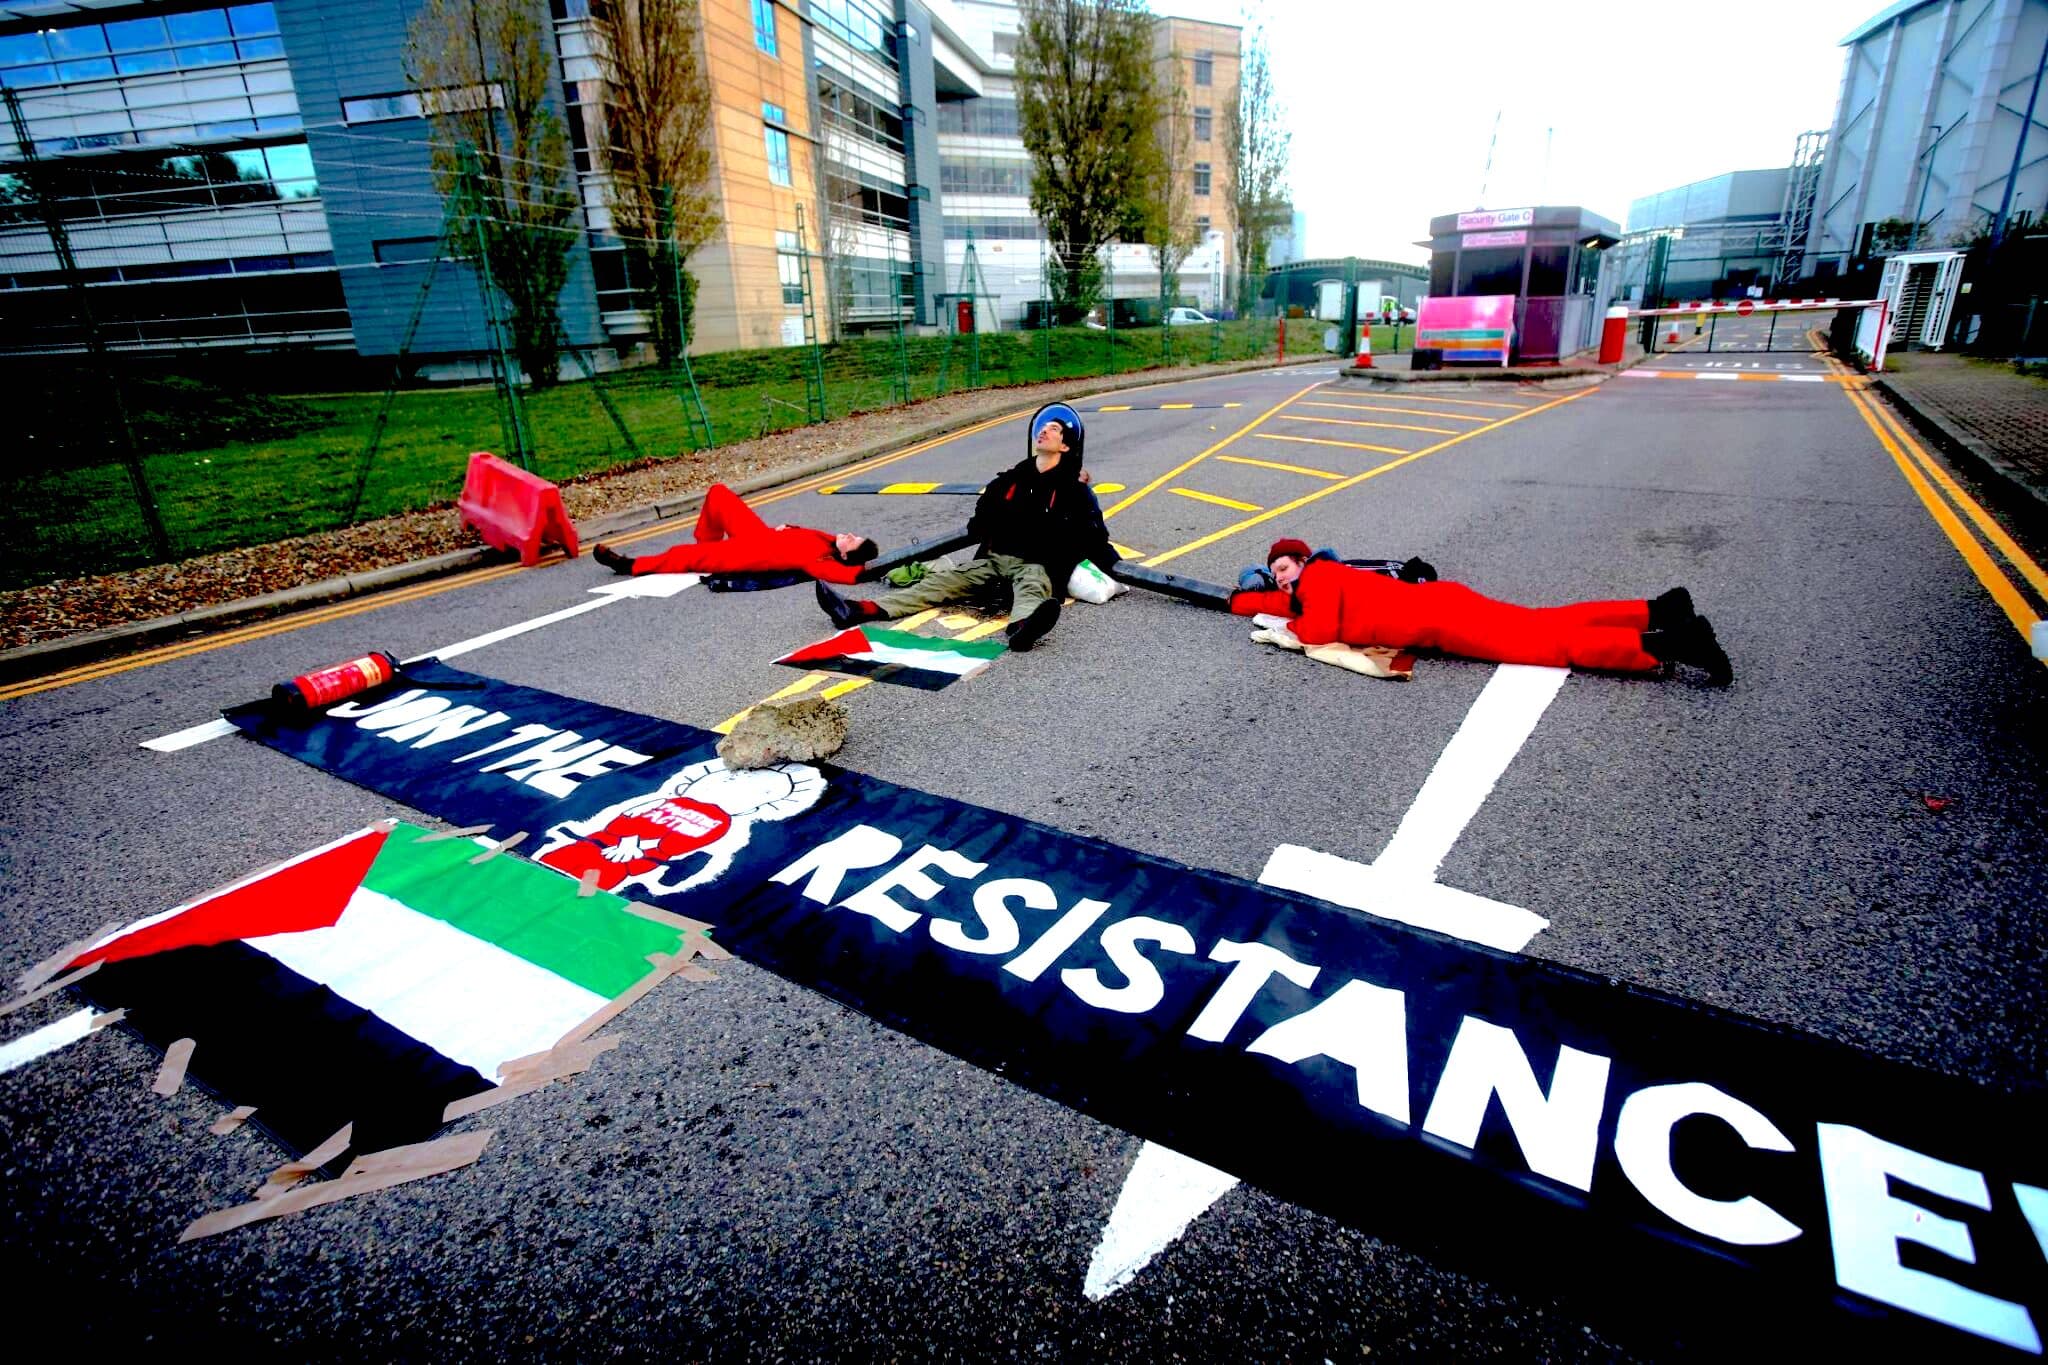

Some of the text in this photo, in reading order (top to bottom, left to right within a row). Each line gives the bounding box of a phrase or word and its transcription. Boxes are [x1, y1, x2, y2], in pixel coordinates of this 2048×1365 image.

[1459, 214, 1495, 225] Security
[1498, 212, 1521, 223] Gate
[452, 723, 654, 799] THE
